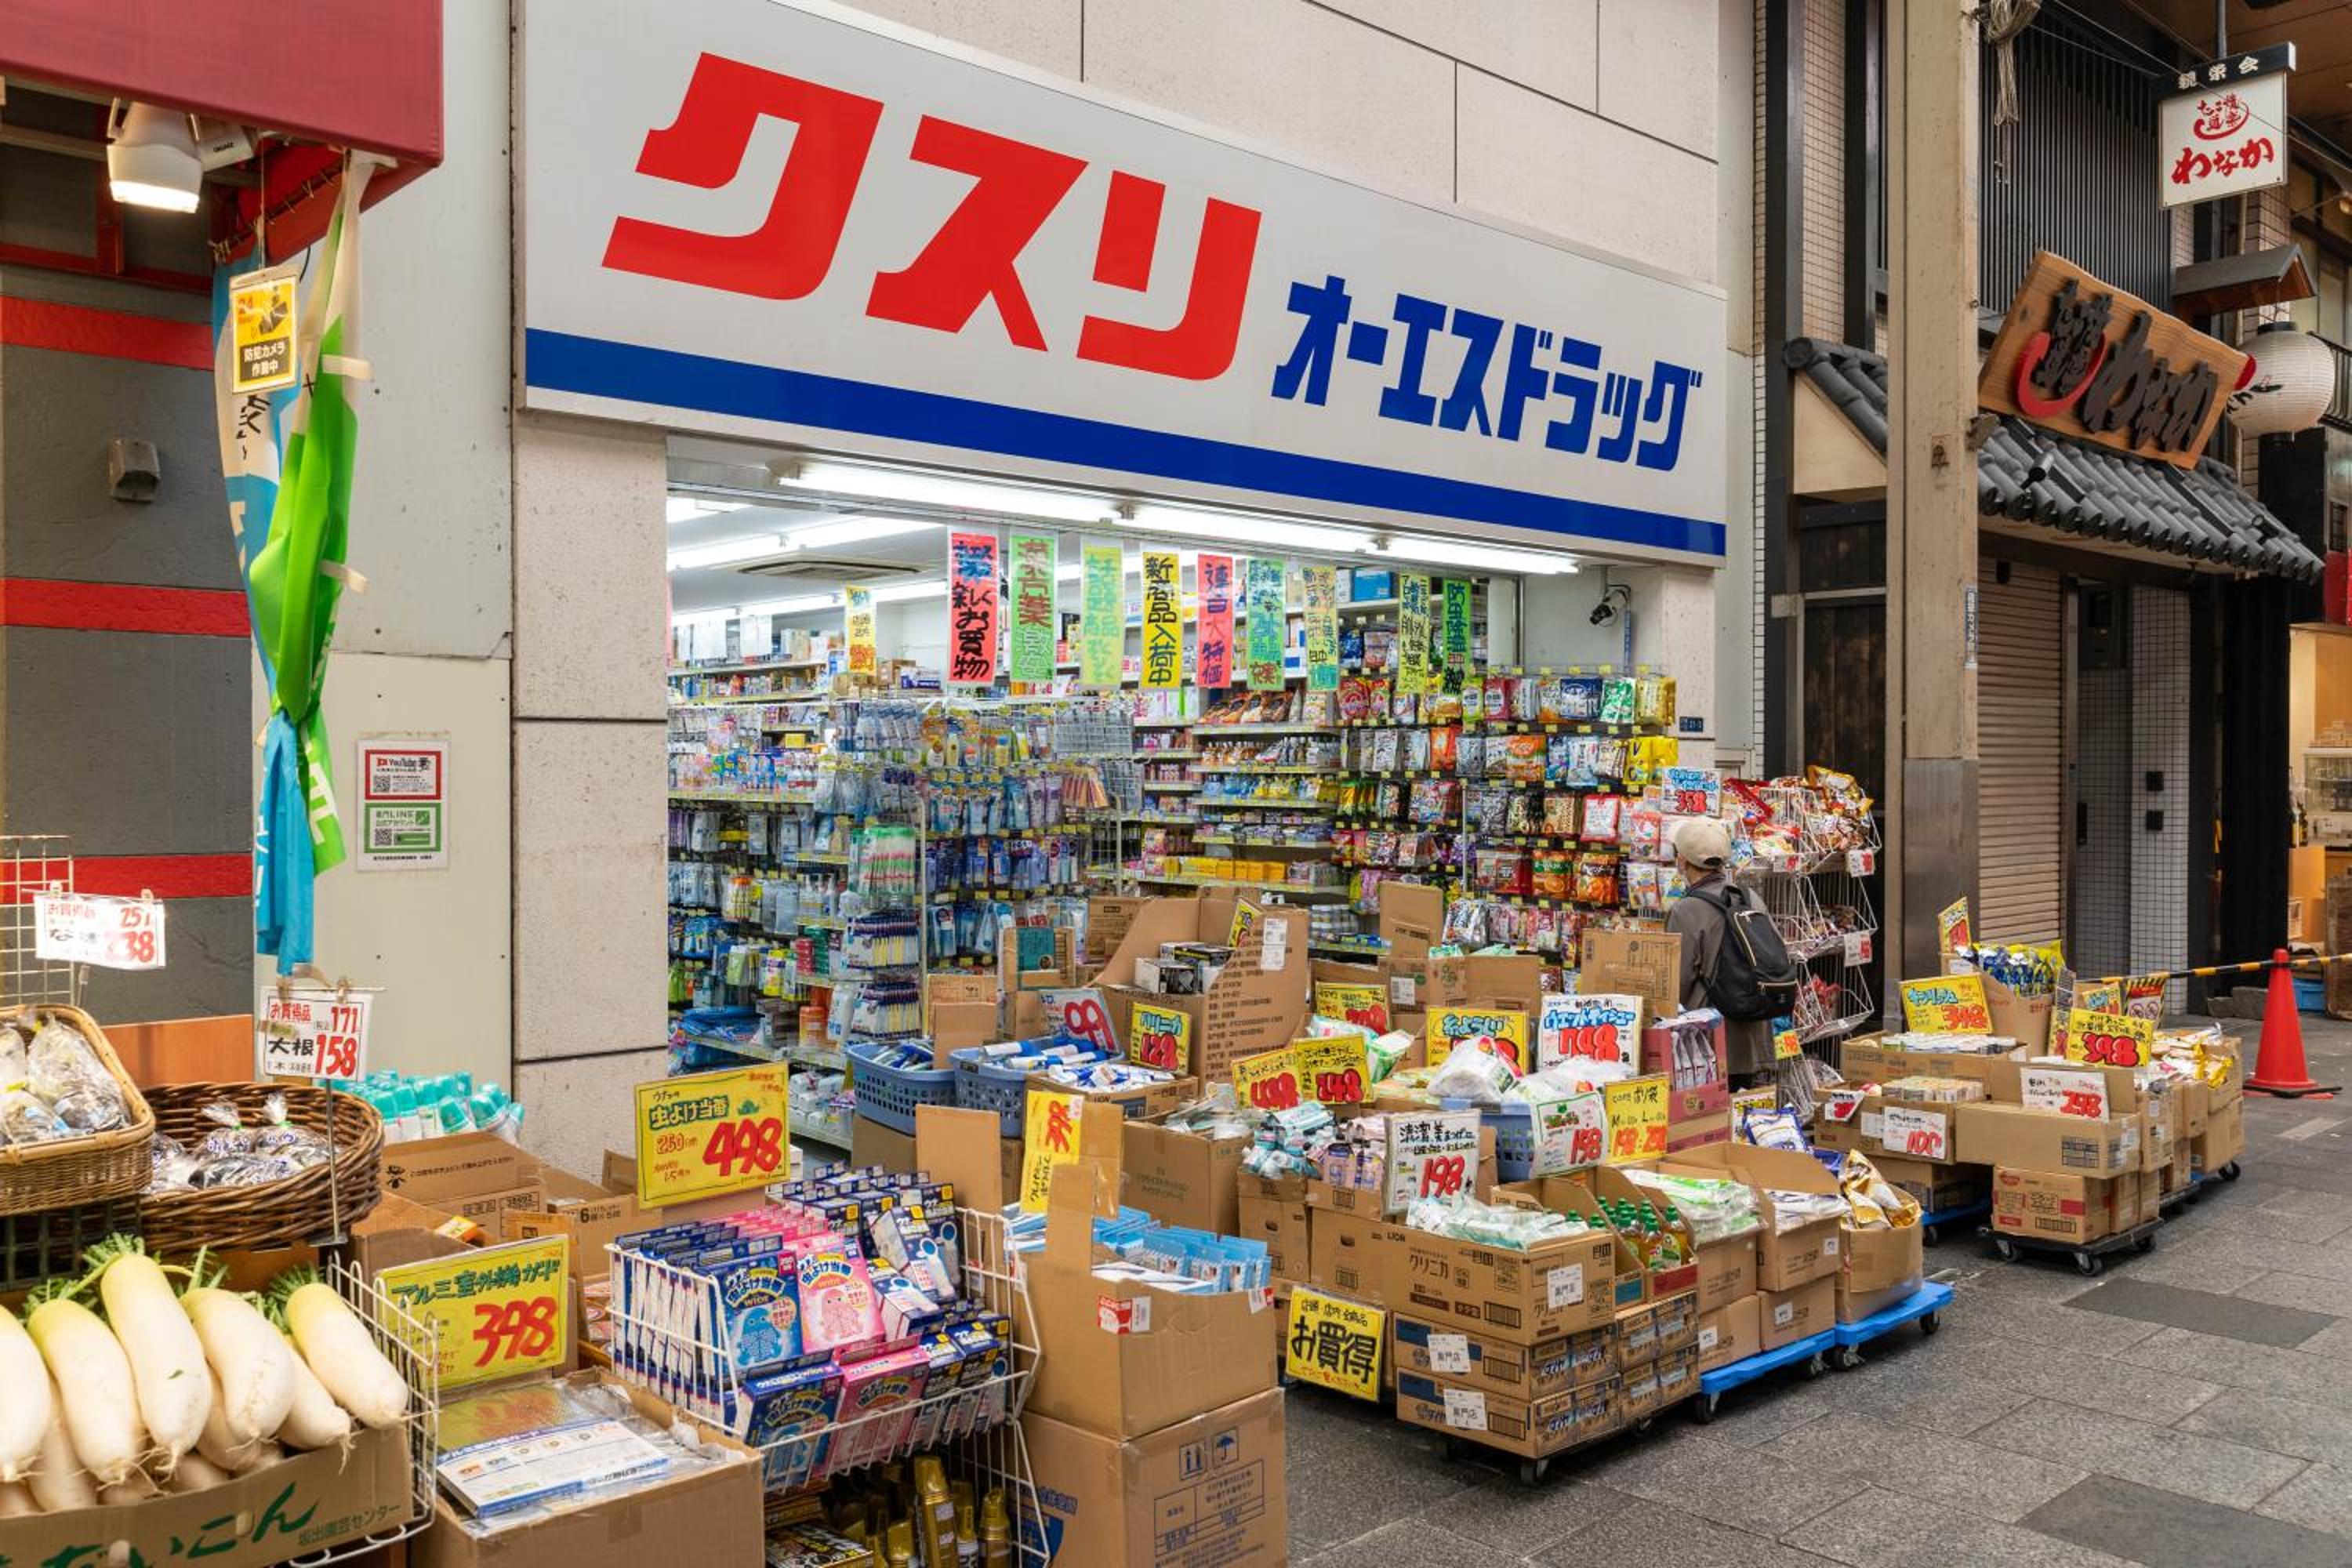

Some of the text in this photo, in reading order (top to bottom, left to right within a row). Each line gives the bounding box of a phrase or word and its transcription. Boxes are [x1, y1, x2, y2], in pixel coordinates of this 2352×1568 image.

[2172, 138, 2274, 184] わなか
[601, 52, 1262, 382] クスリ
[244, 343, 285, 364] 防犯カメラ
[1271, 275, 1703, 470] オーエスドラッグ
[331, 1006, 358, 1033] 171
[268, 1034, 358, 1078] 大根 158
[2082, 1032, 2140, 1067] 398
[650, 1096, 729, 1130] 虫よけ当番
[702, 1117, 783, 1177] 498
[1420, 1153, 1465, 1199] 198
[1387, 1232, 1406, 1243] LION
[1410, 1254, 1449, 1279] クリニカ
[1291, 1315, 1377, 1385] お買得
